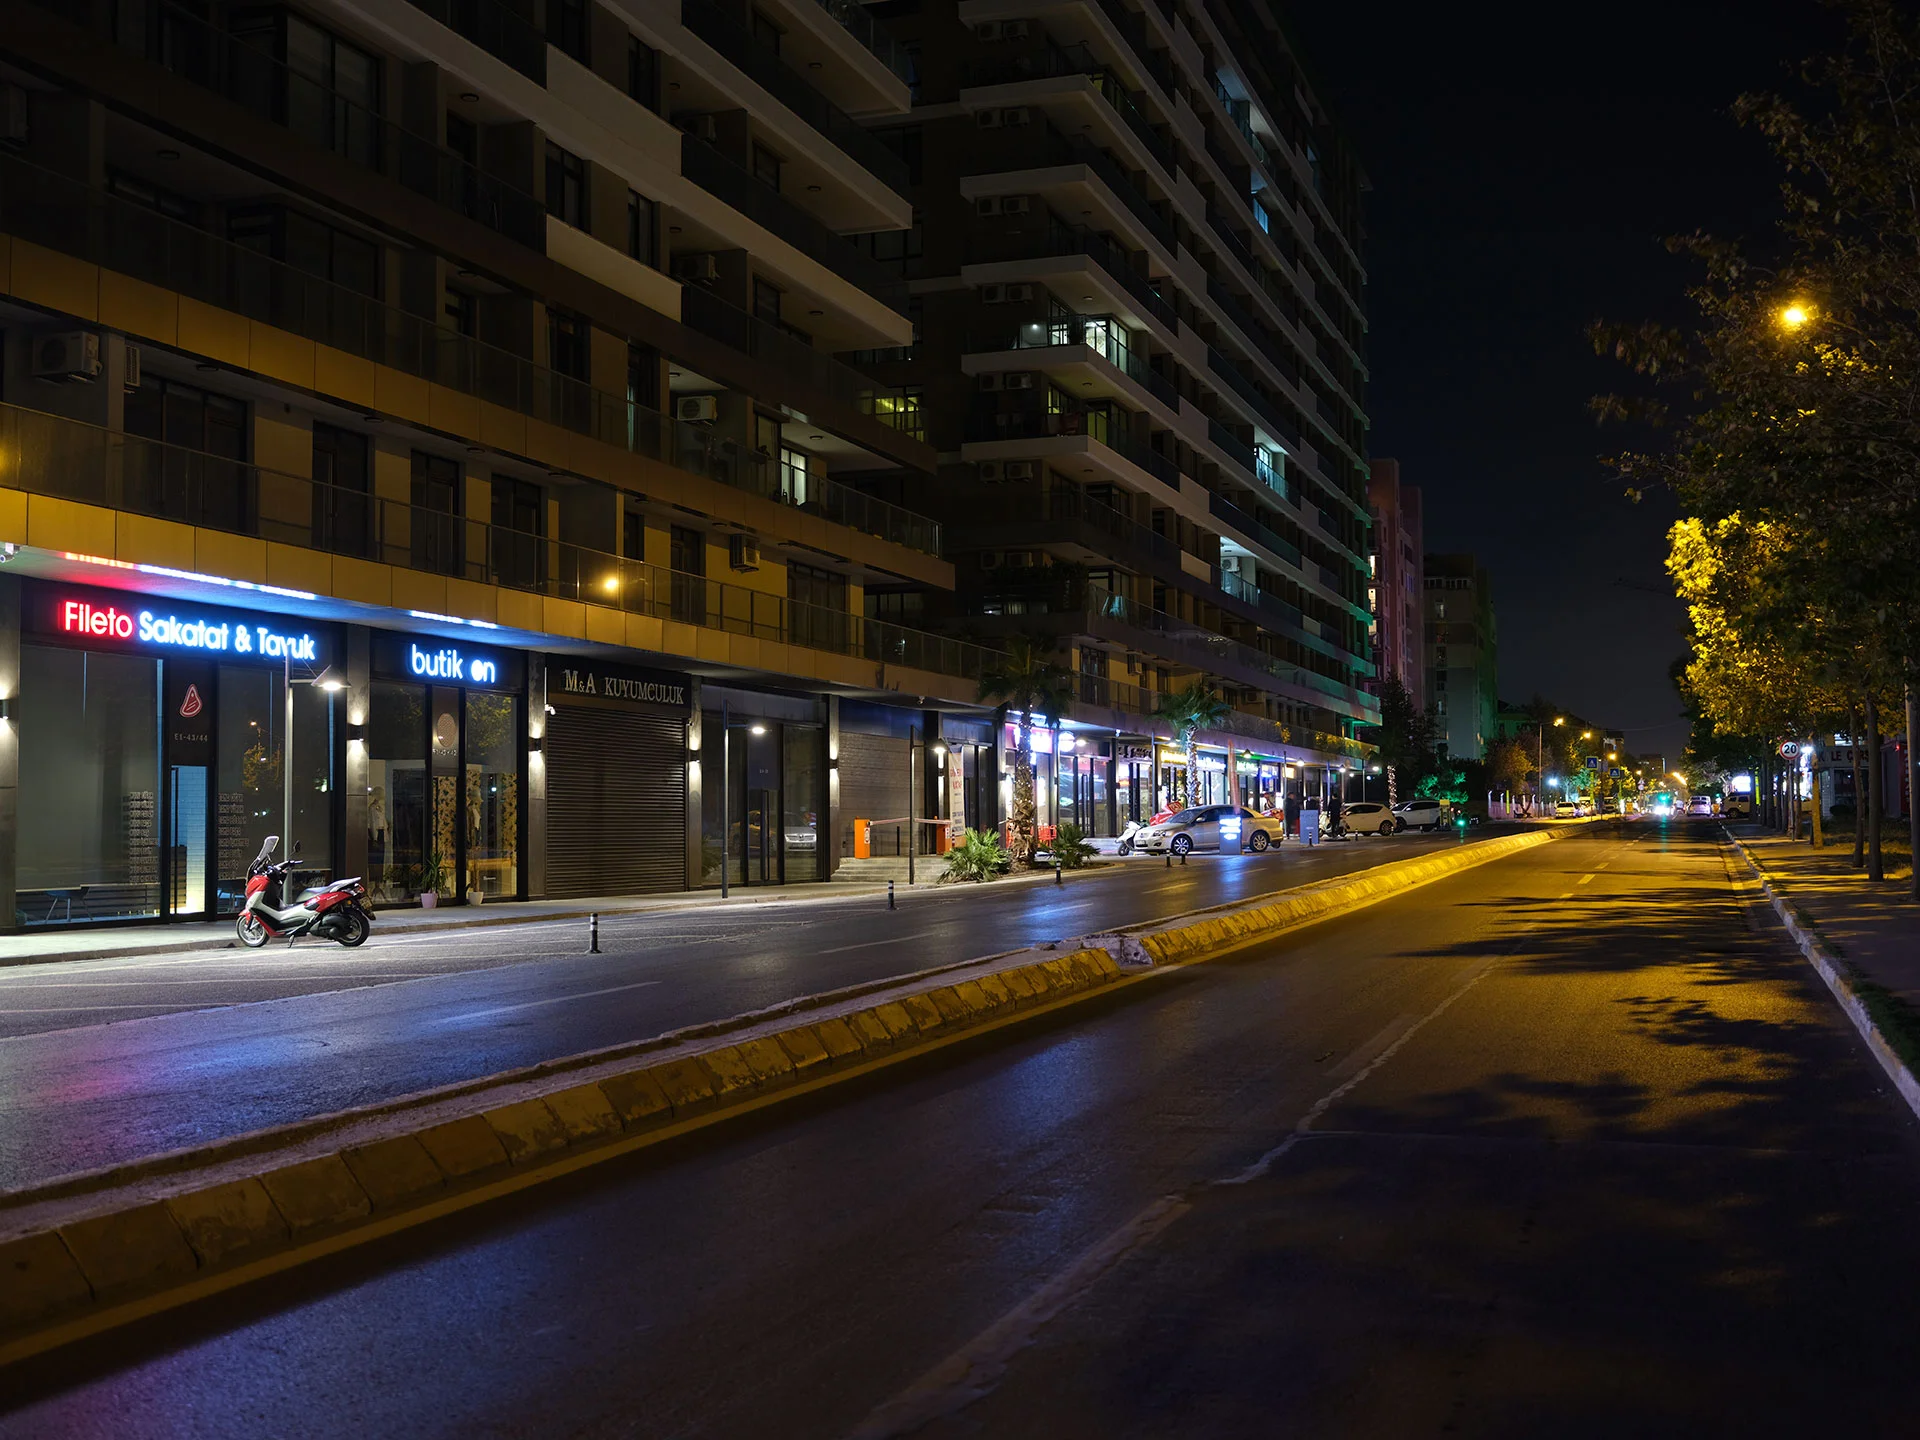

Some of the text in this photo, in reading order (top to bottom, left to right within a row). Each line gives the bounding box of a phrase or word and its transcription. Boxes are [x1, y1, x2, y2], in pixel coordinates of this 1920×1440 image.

[65, 602, 315, 660] Fileto Sakatat & Tavuk
[411, 643, 495, 683] butik on
[564, 669, 684, 704] M&A KUYUMCULUK
[1784, 744, 1797, 754] 20
